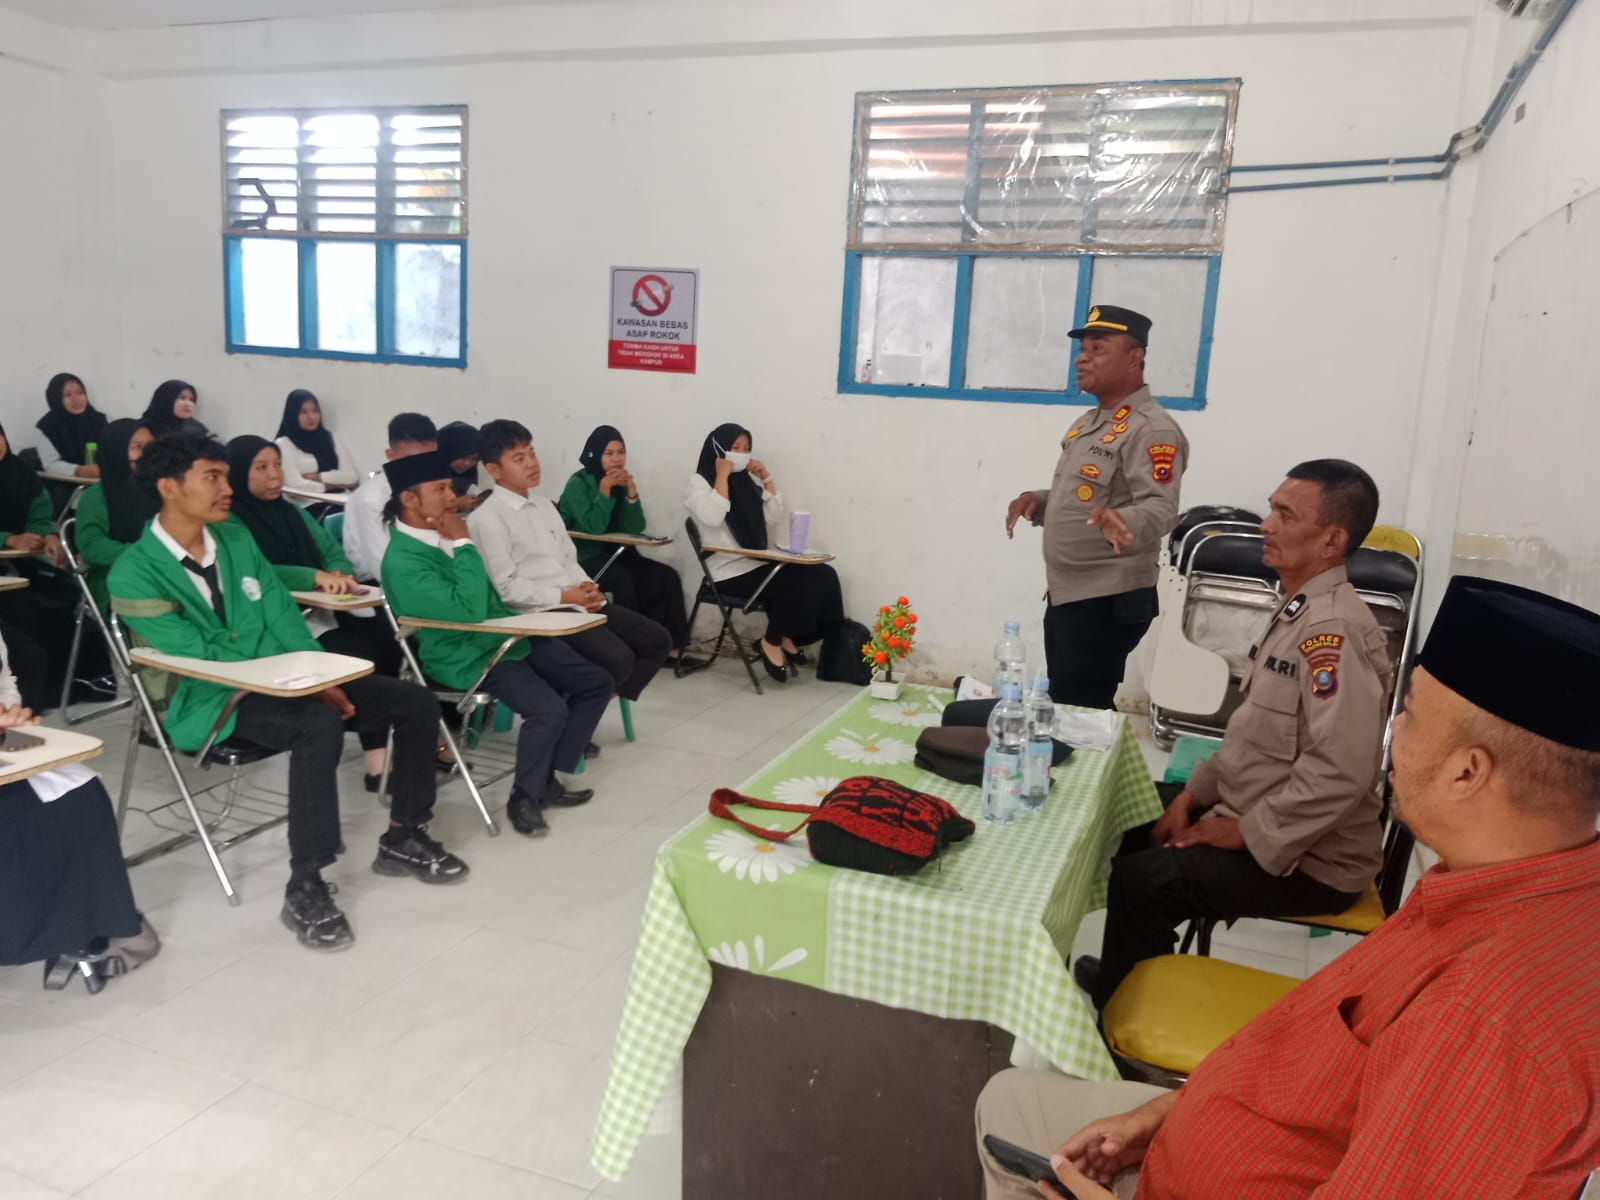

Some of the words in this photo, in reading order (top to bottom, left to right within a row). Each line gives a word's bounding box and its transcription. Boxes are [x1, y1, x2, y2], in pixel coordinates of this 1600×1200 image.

[617, 318, 657, 327] KAWASAN
[660, 320, 688, 329] BEBAS
[626, 330, 648, 338] ASAP
[650, 331, 680, 340] ROKOK
[1301, 635, 1339, 649] POLRES
